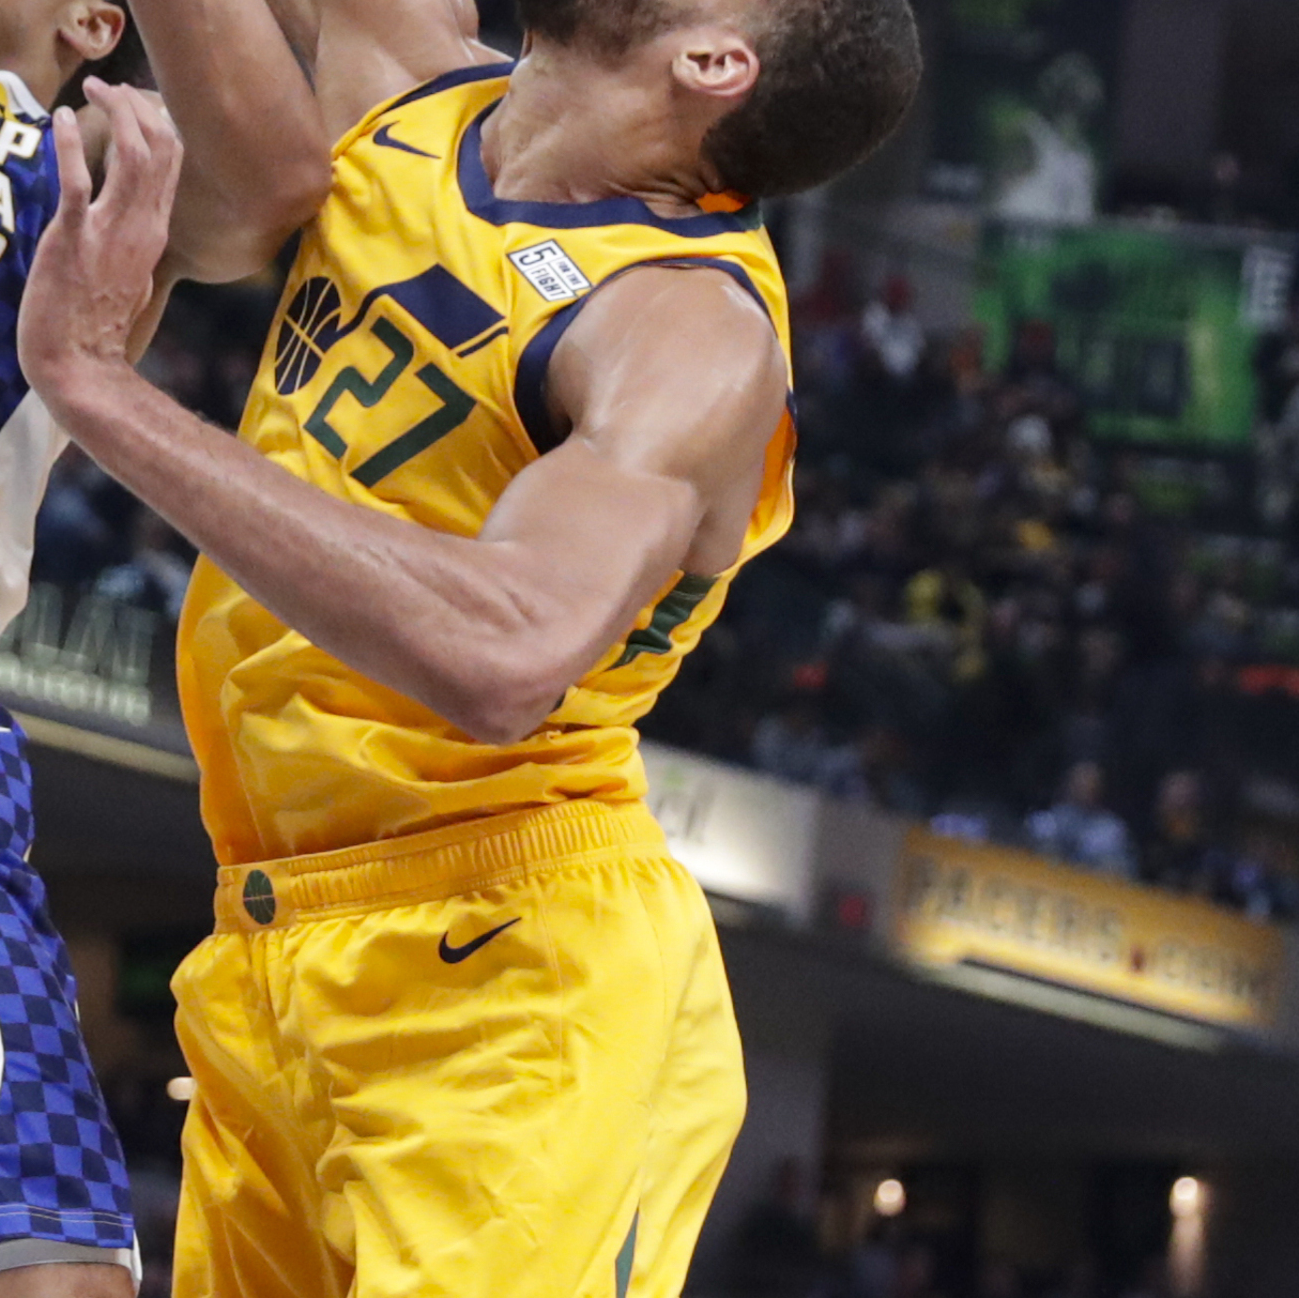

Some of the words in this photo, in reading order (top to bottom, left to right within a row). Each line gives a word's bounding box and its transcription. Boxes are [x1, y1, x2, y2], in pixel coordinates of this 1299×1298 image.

[519, 247, 557, 266] 5
[531, 268, 566, 296] FIGHT
[302, 315, 479, 489] 27
